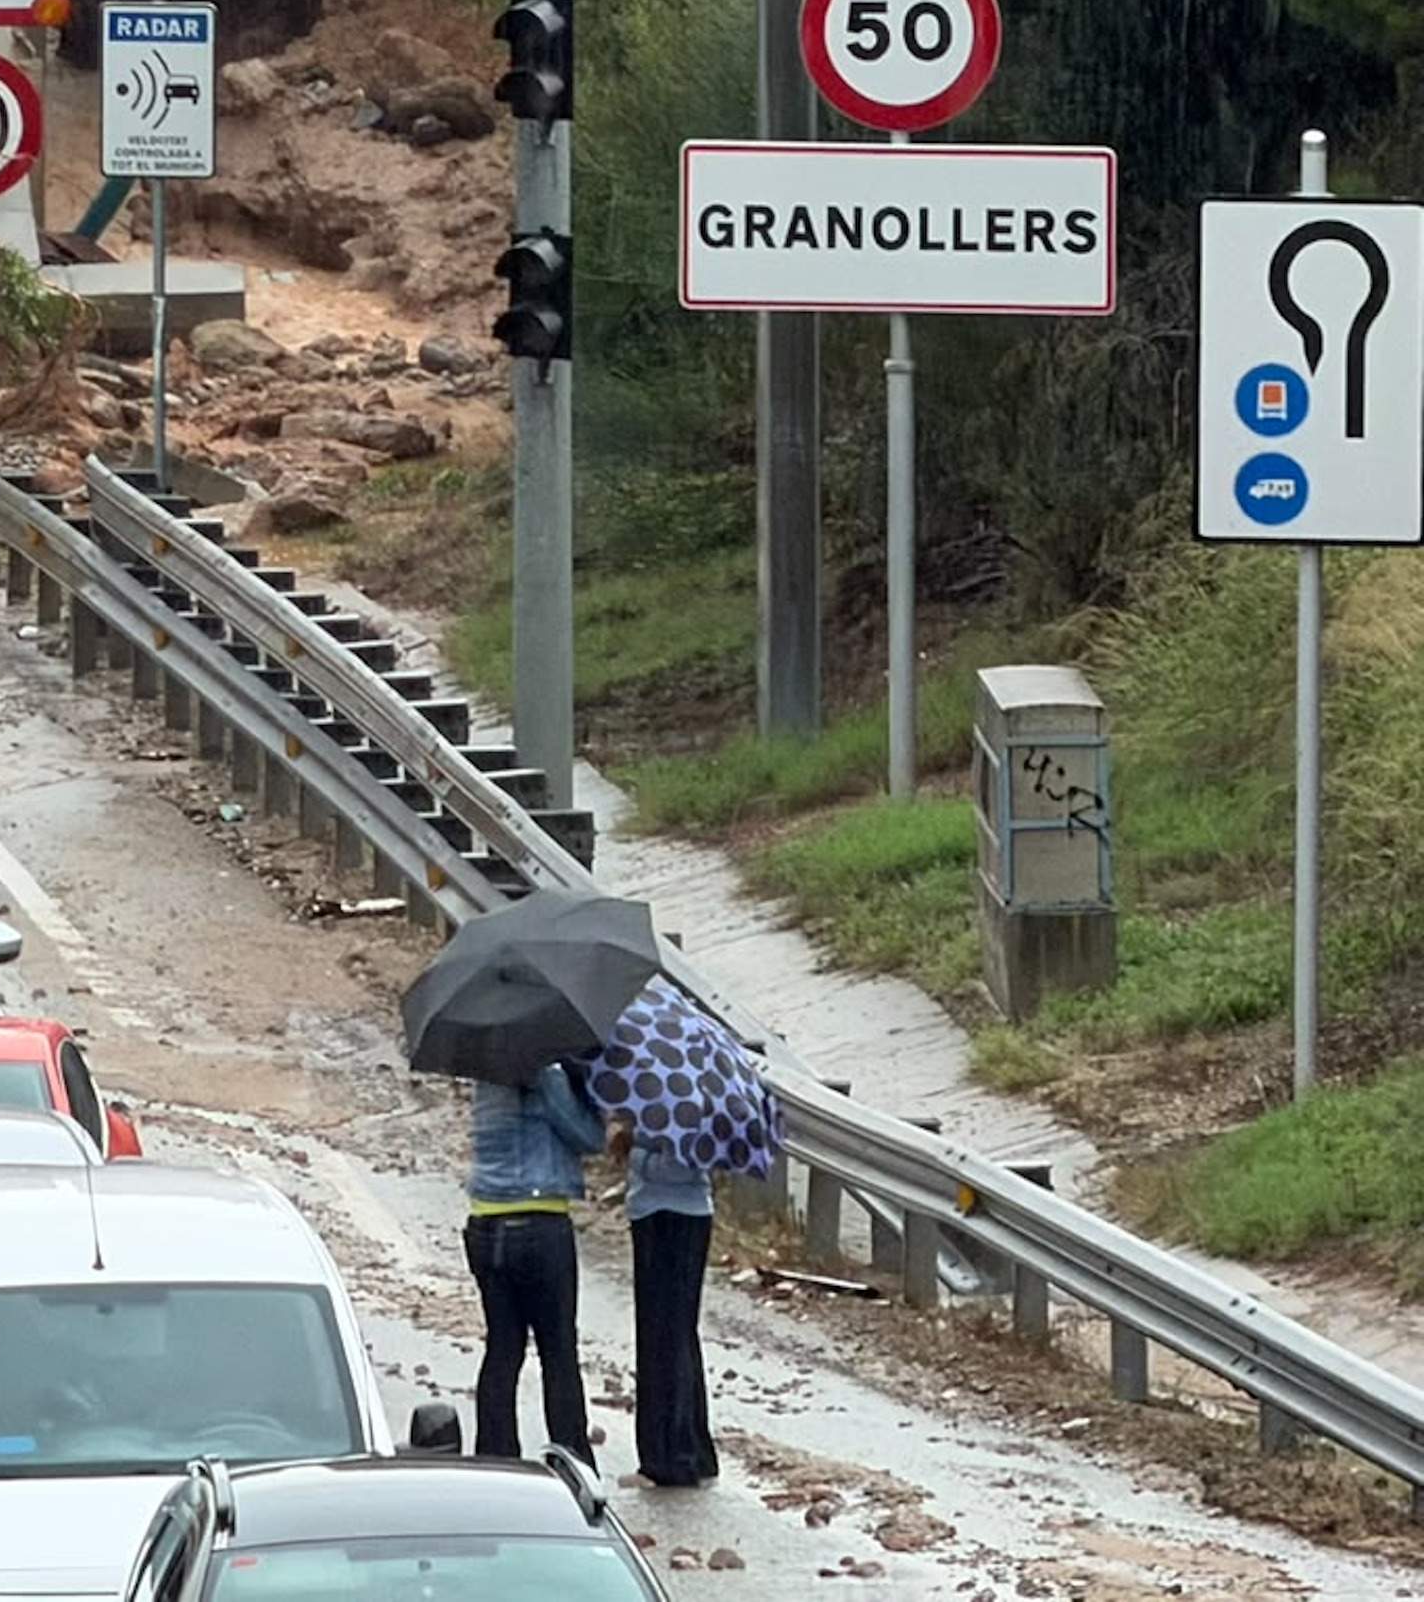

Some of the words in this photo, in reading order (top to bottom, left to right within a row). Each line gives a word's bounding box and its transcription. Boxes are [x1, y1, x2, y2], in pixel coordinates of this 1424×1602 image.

[116, 16, 200, 38] RADAR
[846, 1, 952, 61] 50
[697, 204, 1099, 255] GRANOLLERS
